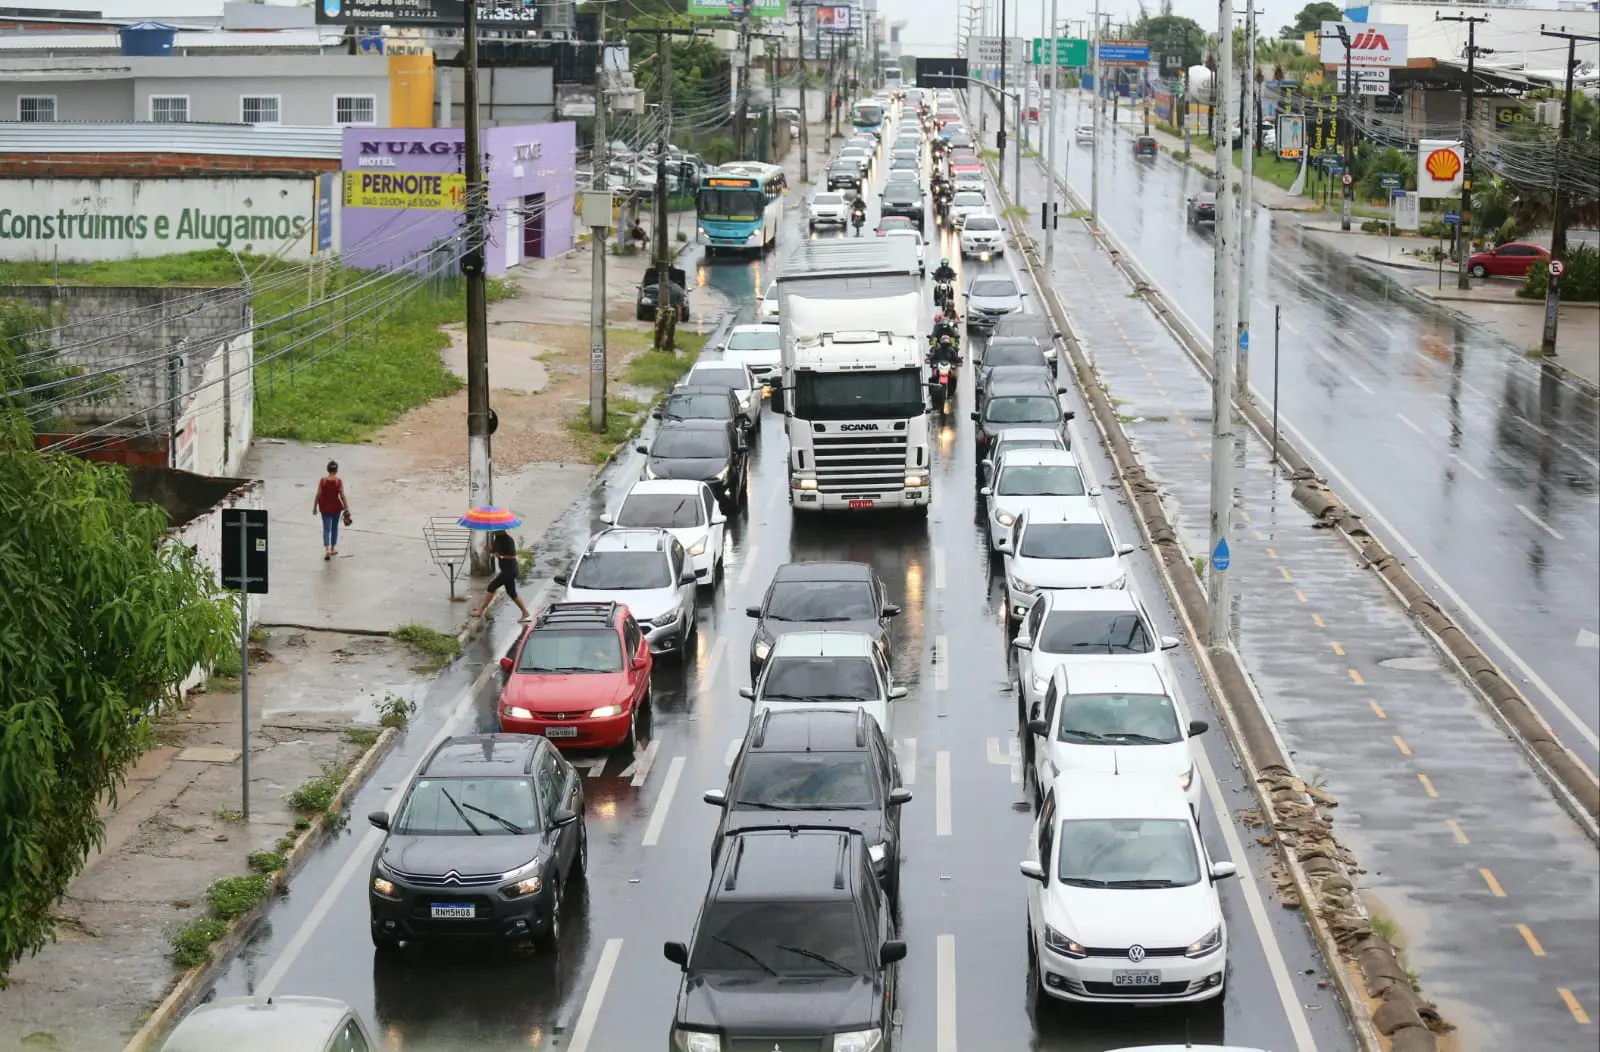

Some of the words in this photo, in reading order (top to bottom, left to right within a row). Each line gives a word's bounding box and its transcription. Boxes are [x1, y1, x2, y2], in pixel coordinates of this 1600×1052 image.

[352, 8, 394, 18] Nordeste
[1343, 53, 1377, 63] Sopping
[359, 156, 395, 167] MOTEL
[362, 173, 442, 195] PERNOITE
[154, 214, 169, 238] e
[176, 208, 305, 248] Alugamos
[840, 423, 879, 431] SCANIA
[1135, 975, 1159, 985] 8749
